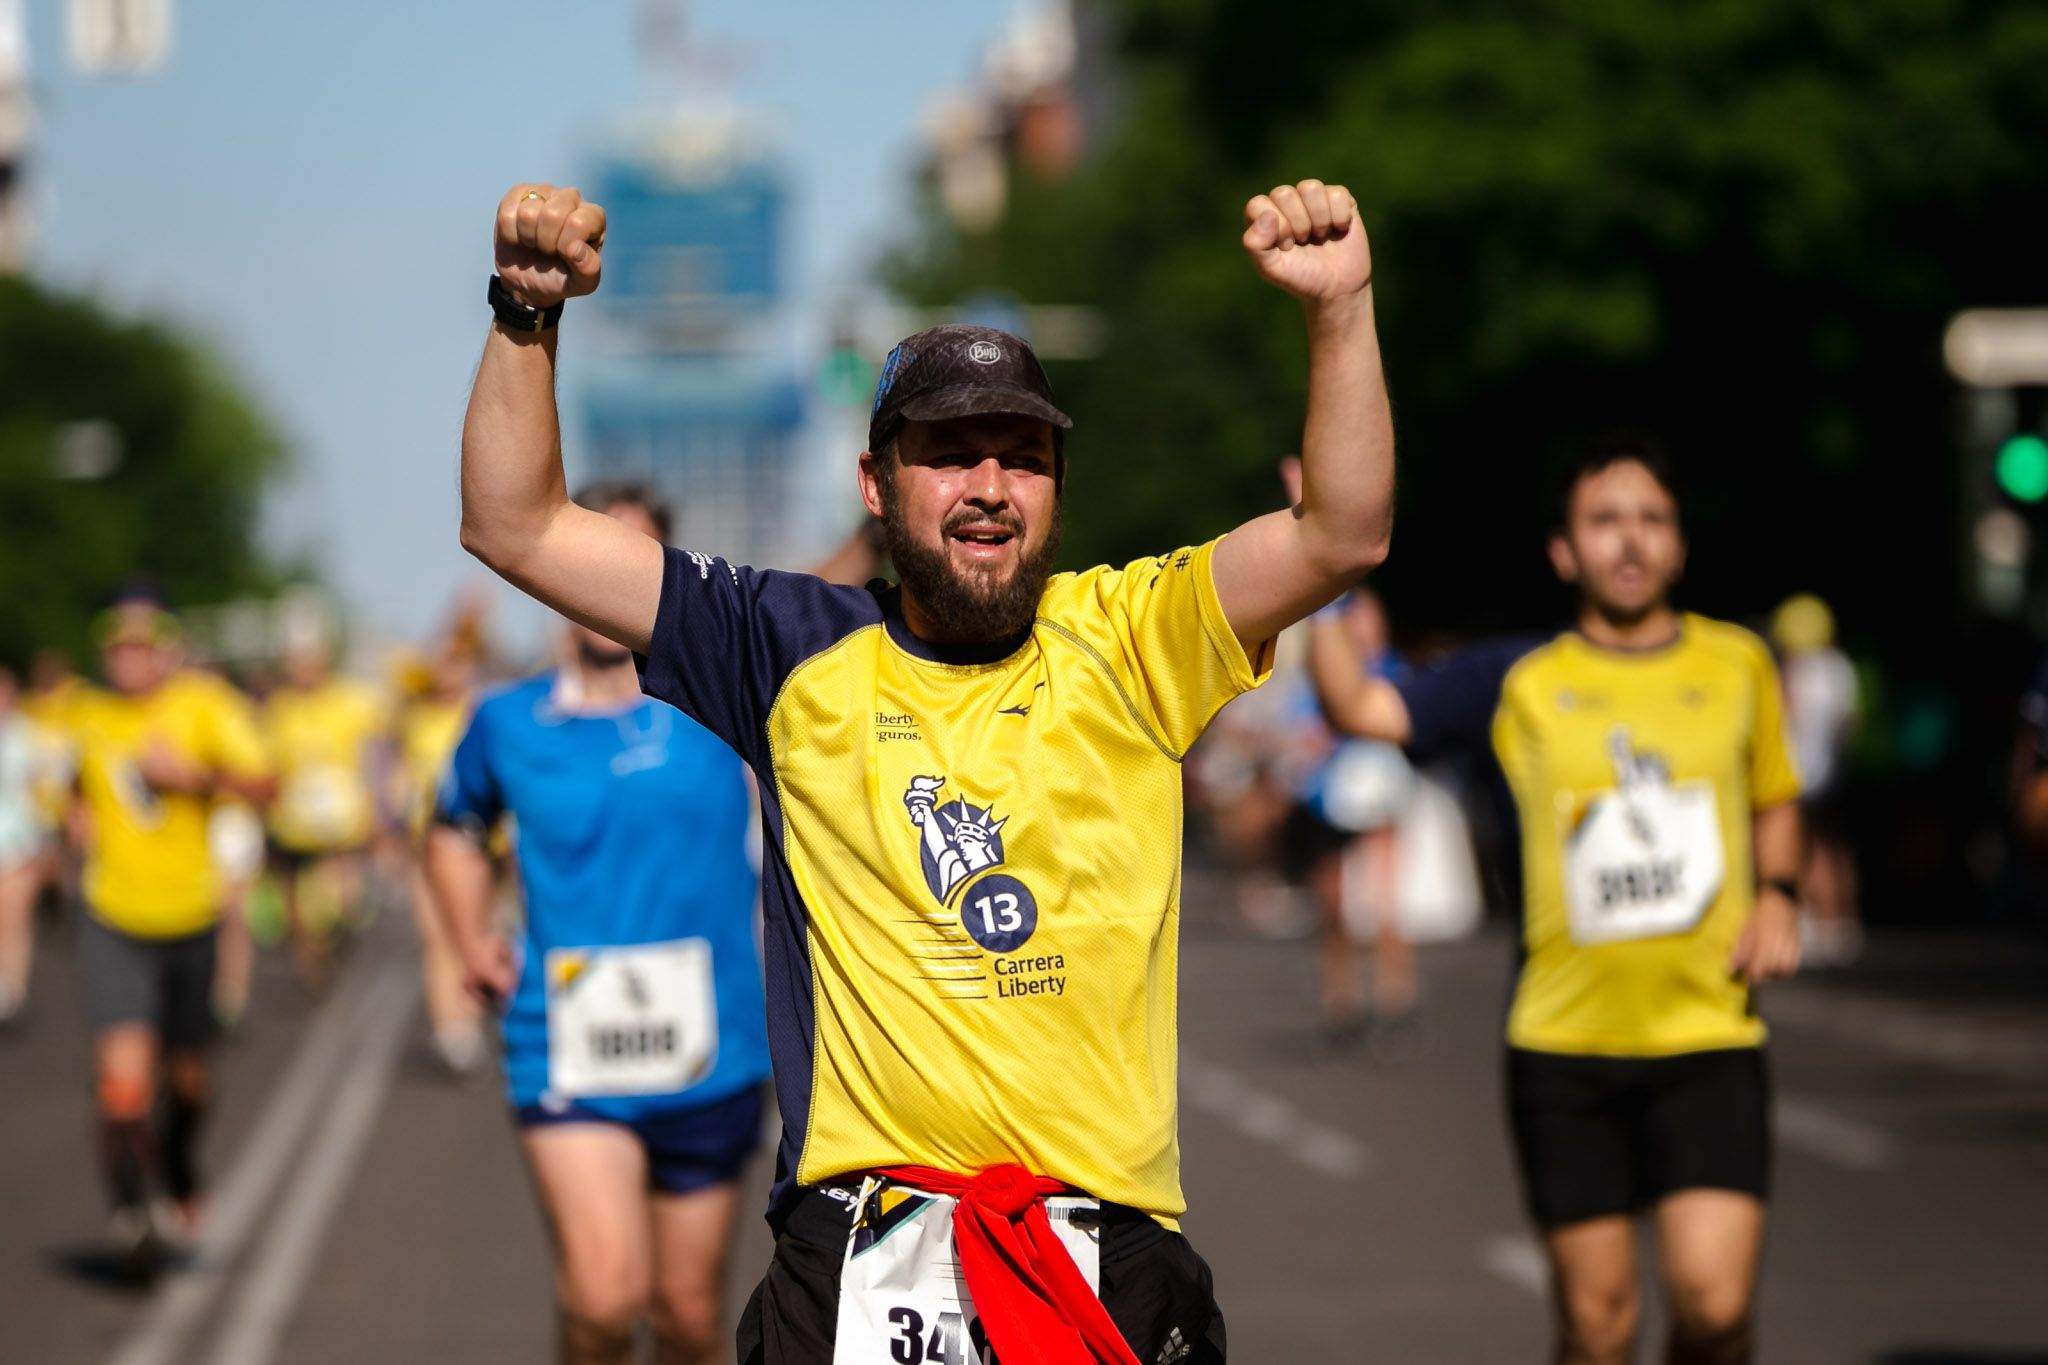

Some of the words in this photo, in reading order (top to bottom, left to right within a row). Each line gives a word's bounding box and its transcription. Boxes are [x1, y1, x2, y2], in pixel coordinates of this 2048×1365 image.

[876, 711, 914, 729] iberty
[876, 731, 922, 742] guros.
[975, 893, 1022, 934] 13
[994, 954, 1065, 976] Carrera
[998, 976, 1066, 998] Liberty
